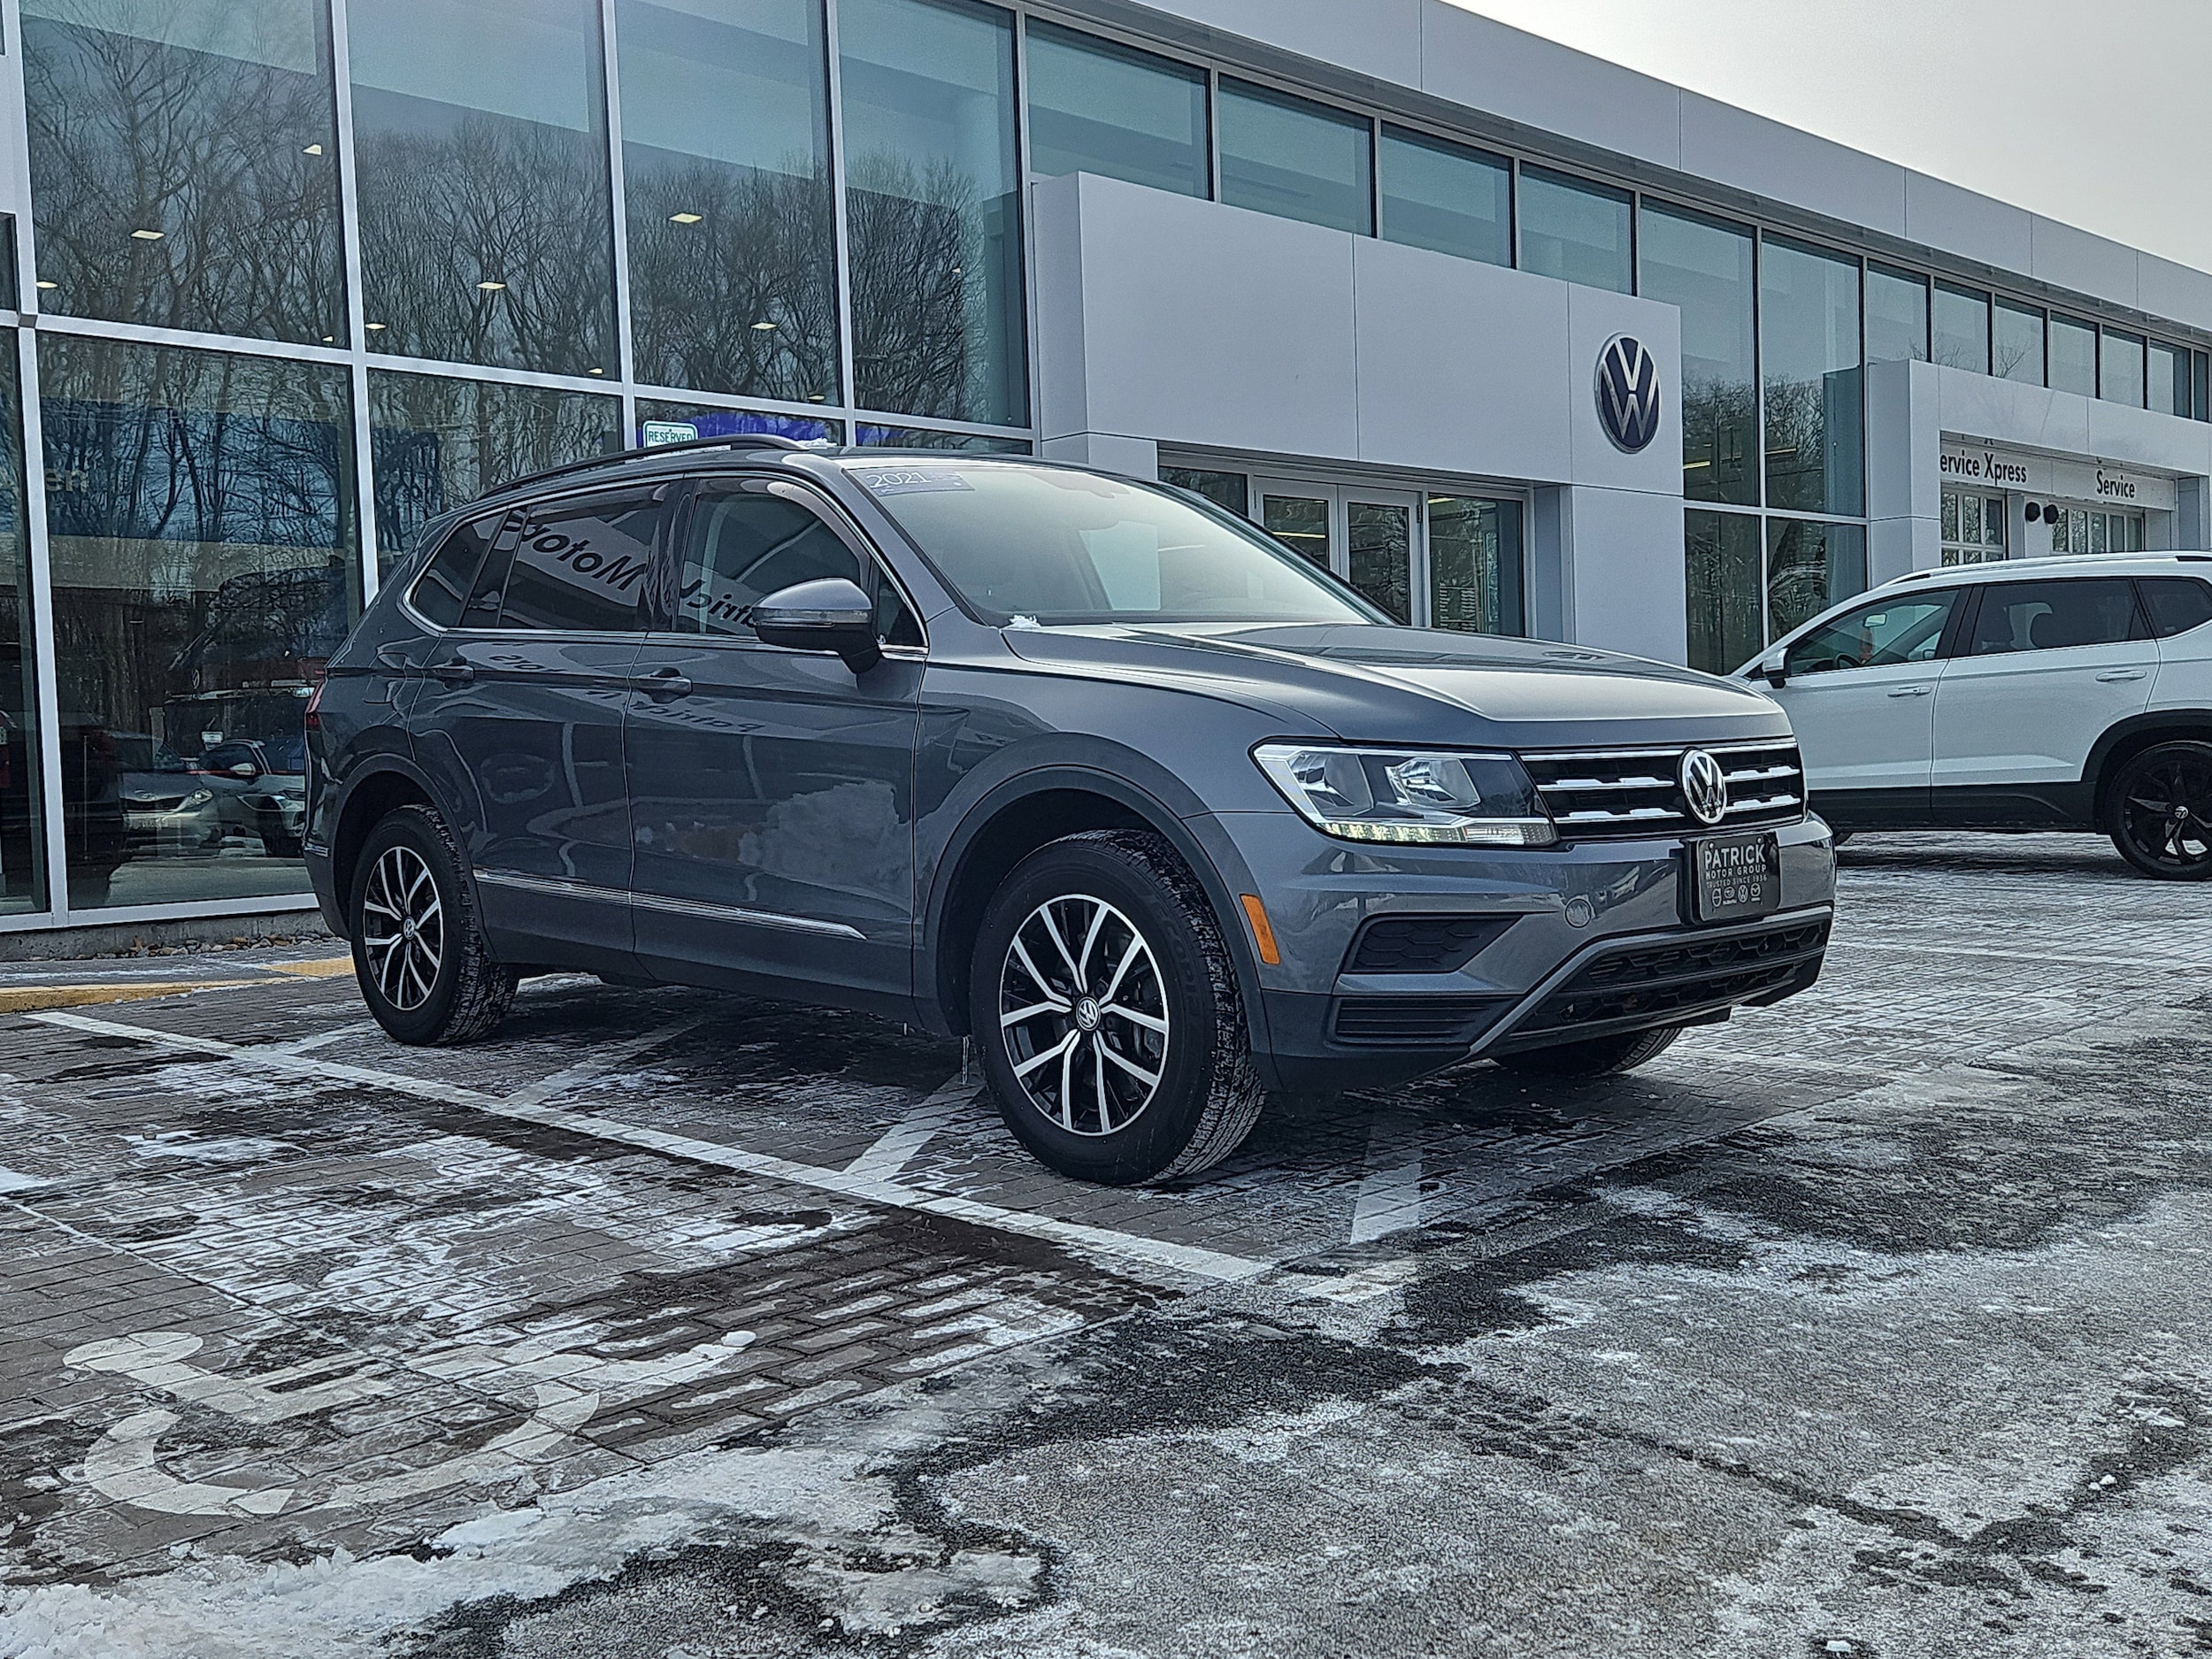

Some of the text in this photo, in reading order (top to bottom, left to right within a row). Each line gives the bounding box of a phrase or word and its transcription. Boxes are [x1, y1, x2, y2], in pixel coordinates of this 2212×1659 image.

[648, 431, 693, 442] RESERVED
[1940, 449, 2027, 487] ervice Xpress
[866, 472, 932, 488] 2021
[2097, 470, 2135, 498] Service
[1704, 843, 1766, 870] PATRICK
[1705, 864, 1767, 880] MOTOR GROUP
